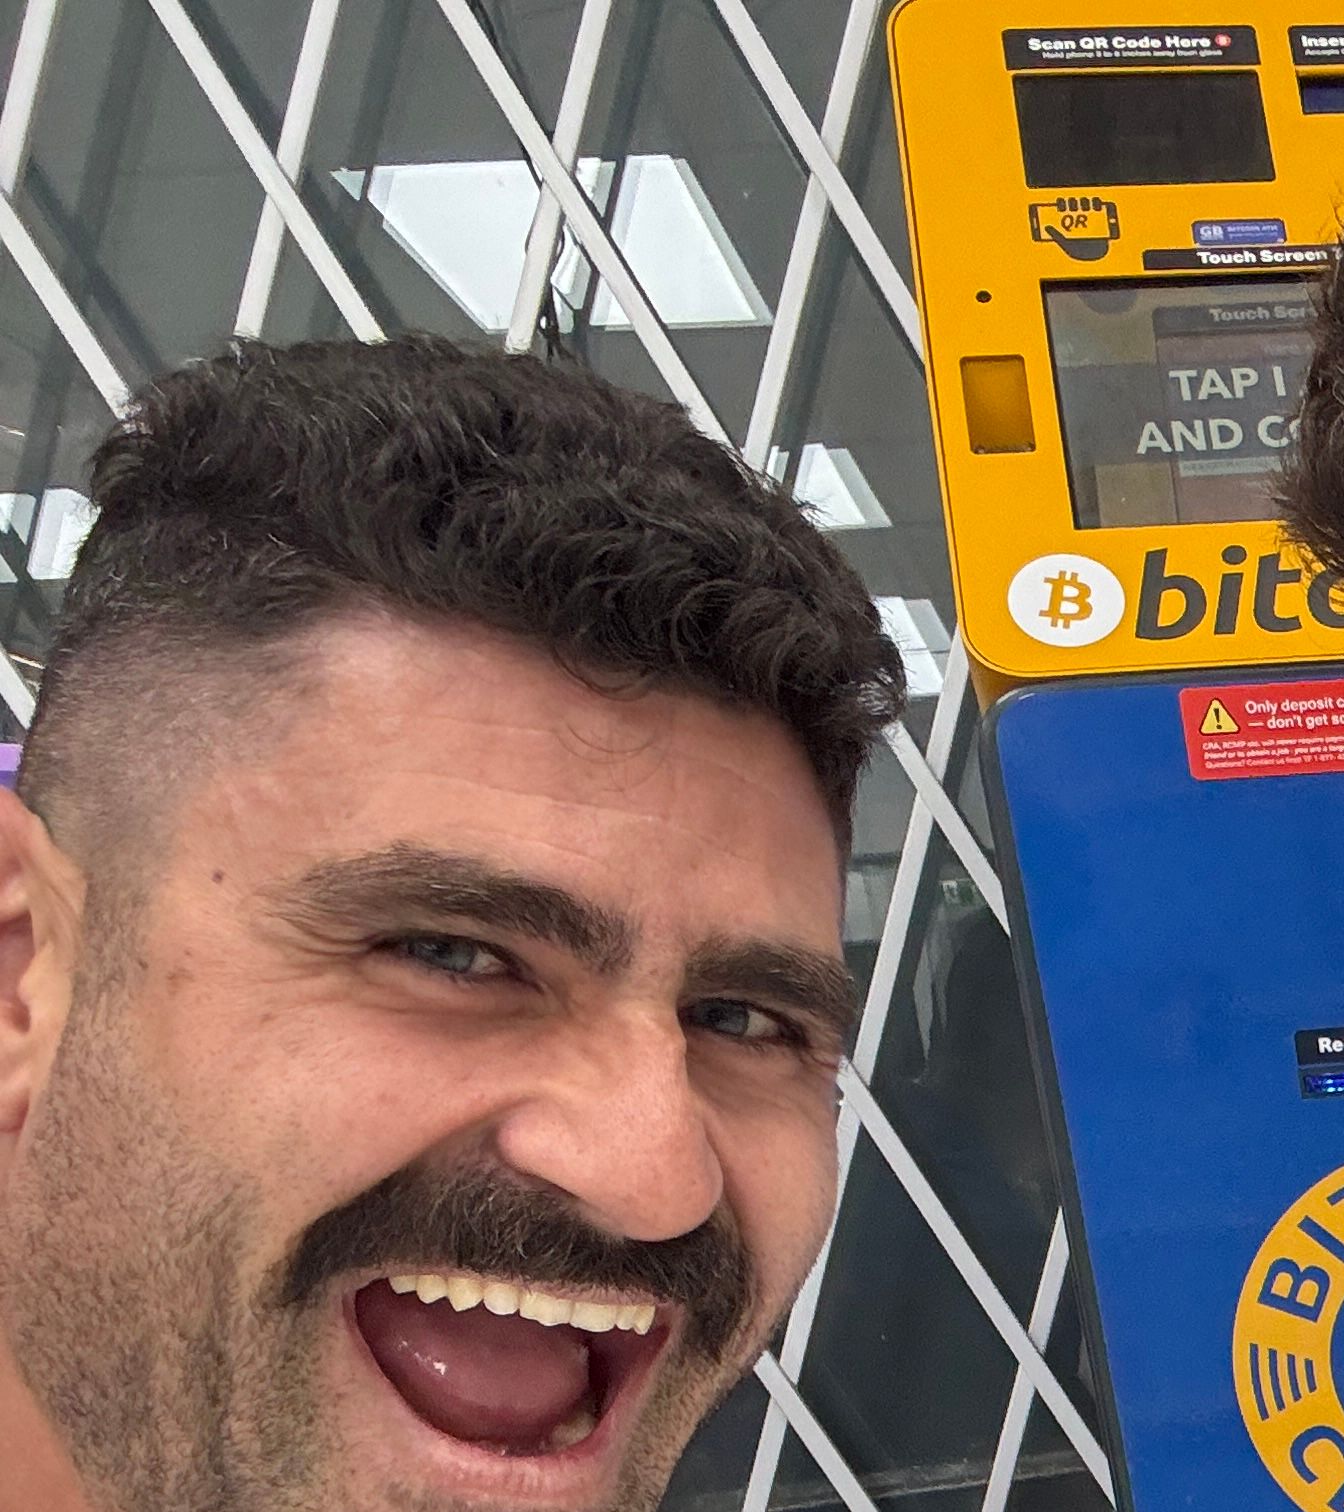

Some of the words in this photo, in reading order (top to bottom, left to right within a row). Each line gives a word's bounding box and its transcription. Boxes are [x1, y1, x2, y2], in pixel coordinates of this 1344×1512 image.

[1028, 37, 1076, 50] Scan
[1079, 36, 1109, 49] QR
[1111, 35, 1161, 49] Code
[1165, 35, 1211, 48] Here
[1060, 215, 1088, 230] QR
[1200, 225, 1224, 236] GB
[1197, 251, 1257, 264] Touch
[1260, 249, 1328, 263] Screen
[1209, 307, 1270, 322] Touch
[1168, 367, 1258, 401] TAP
[1272, 365, 1287, 397] I
[1136, 418, 1243, 455] AND
[1245, 700, 1278, 716] Only
[1280, 696, 1334, 714] deposit
[1267, 715, 1303, 729] don't
[1306, 714, 1329, 729] get
